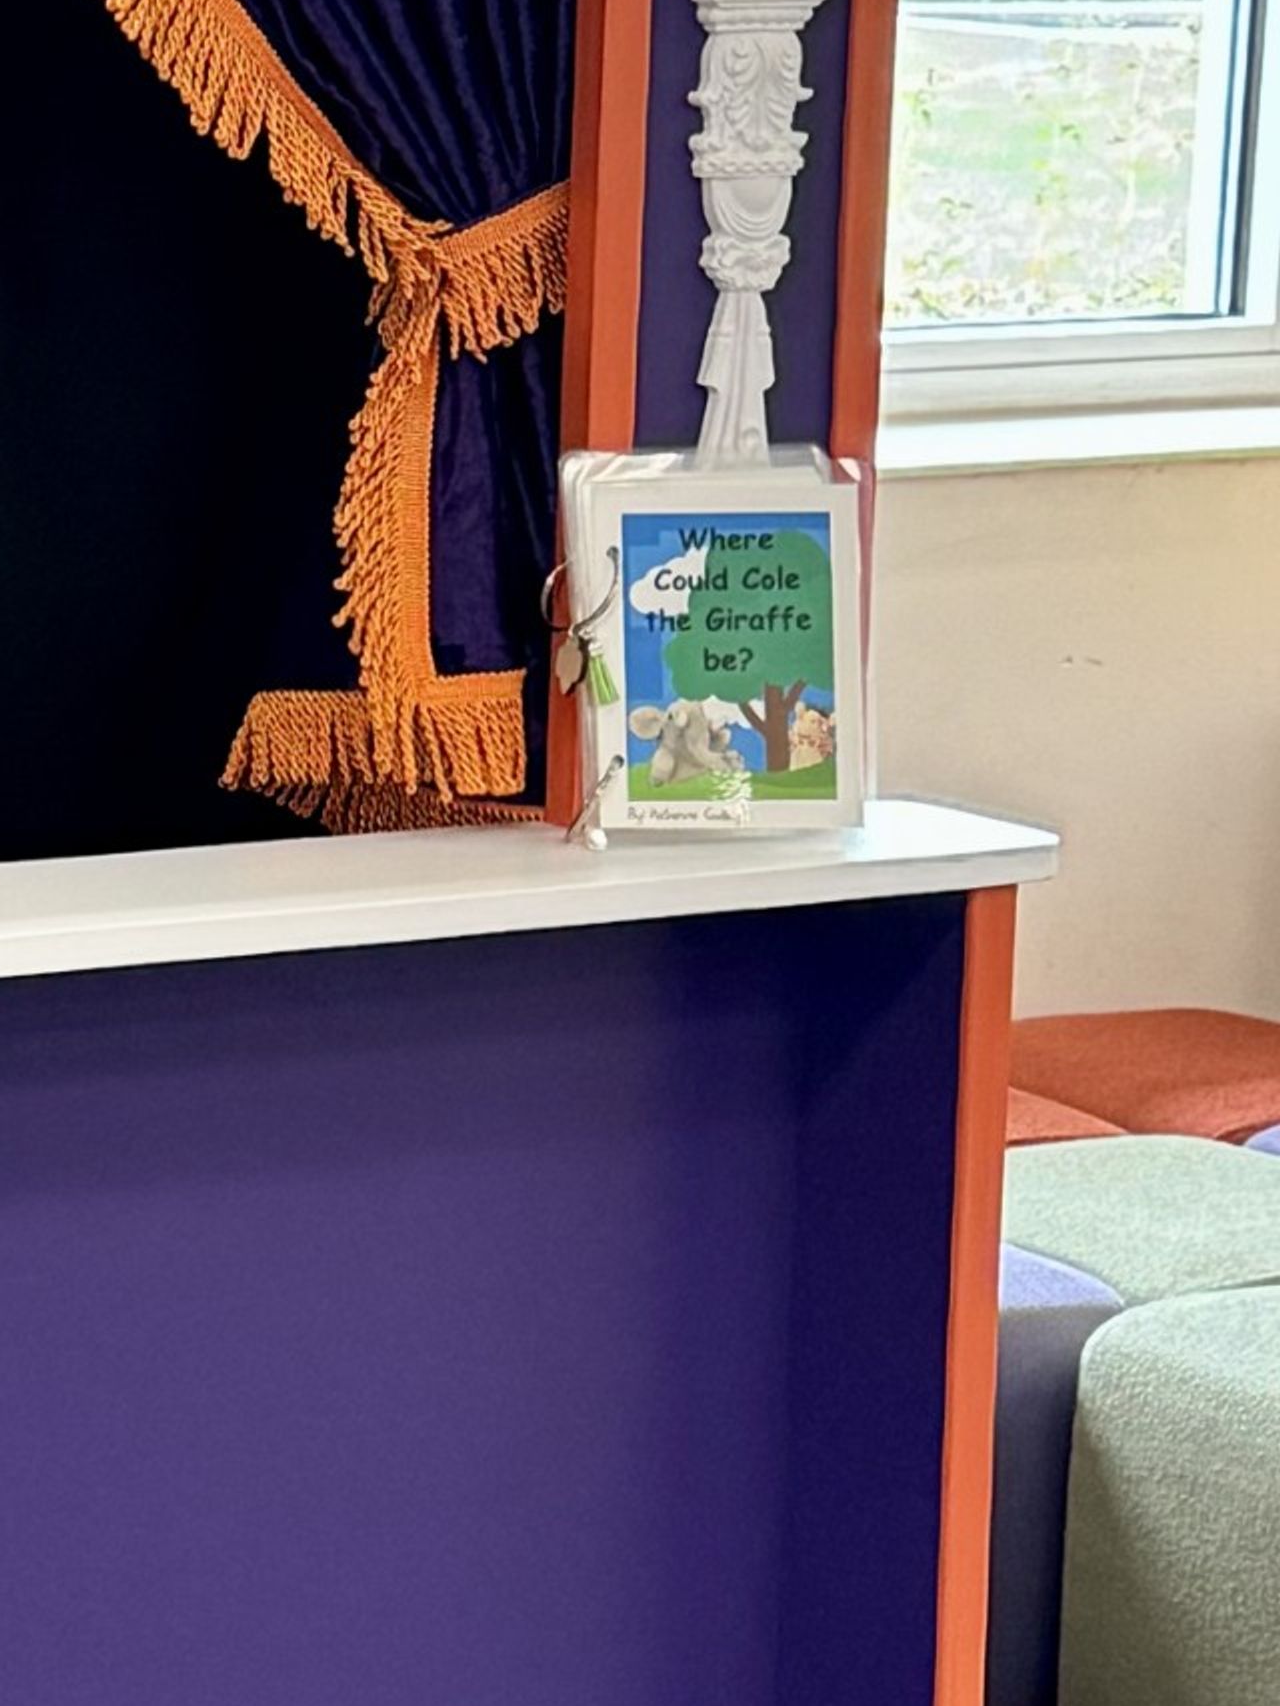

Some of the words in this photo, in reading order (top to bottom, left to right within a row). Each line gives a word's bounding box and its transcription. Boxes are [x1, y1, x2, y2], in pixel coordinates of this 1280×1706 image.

[678, 527, 774, 551] Where
[653, 566, 729, 591] Could
[741, 565, 801, 591] Cole
[645, 607, 692, 632] the
[705, 605, 813, 632] Giraffe
[703, 647, 754, 672] be?
